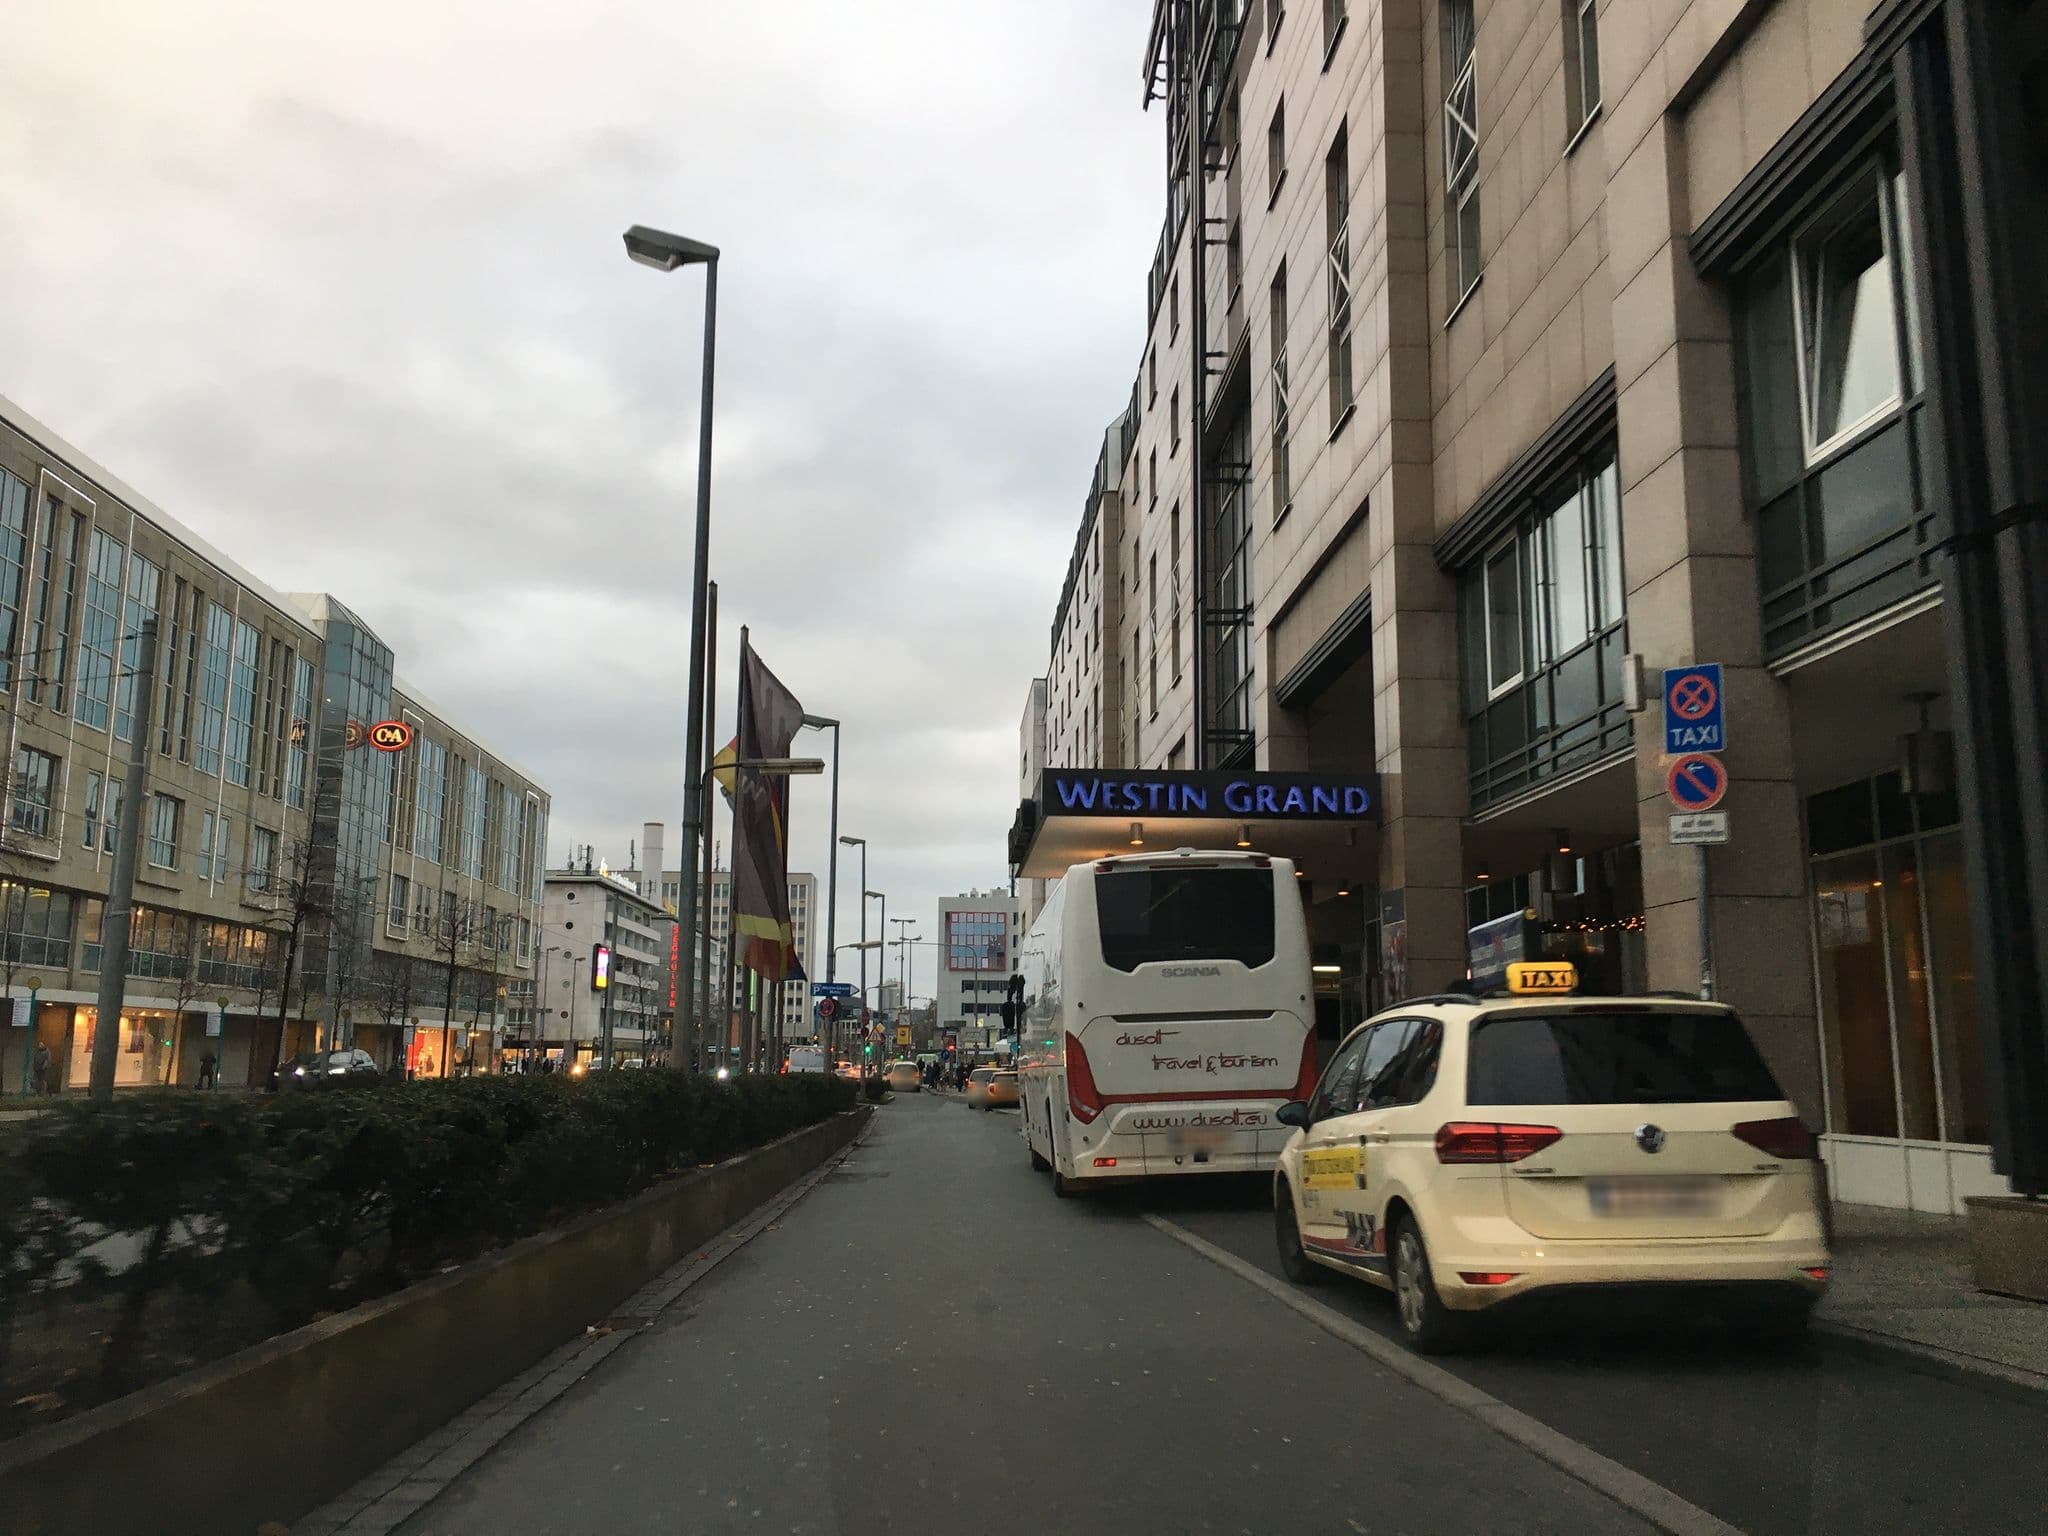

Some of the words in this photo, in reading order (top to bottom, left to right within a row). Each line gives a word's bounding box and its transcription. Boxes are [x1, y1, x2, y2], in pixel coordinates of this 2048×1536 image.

[376, 728, 403, 743] C&A
[1669, 724, 1719, 746] TAXI
[1055, 777, 1209, 811] WESTIN
[1223, 780, 1371, 814] GRAND
[1161, 967, 1221, 977] SCANIA
[1521, 971, 1573, 987] TAXI
[1152, 1054, 1202, 1070] travel
[1206, 1055, 1218, 1075] &
[1219, 1052, 1278, 1068] tourism
